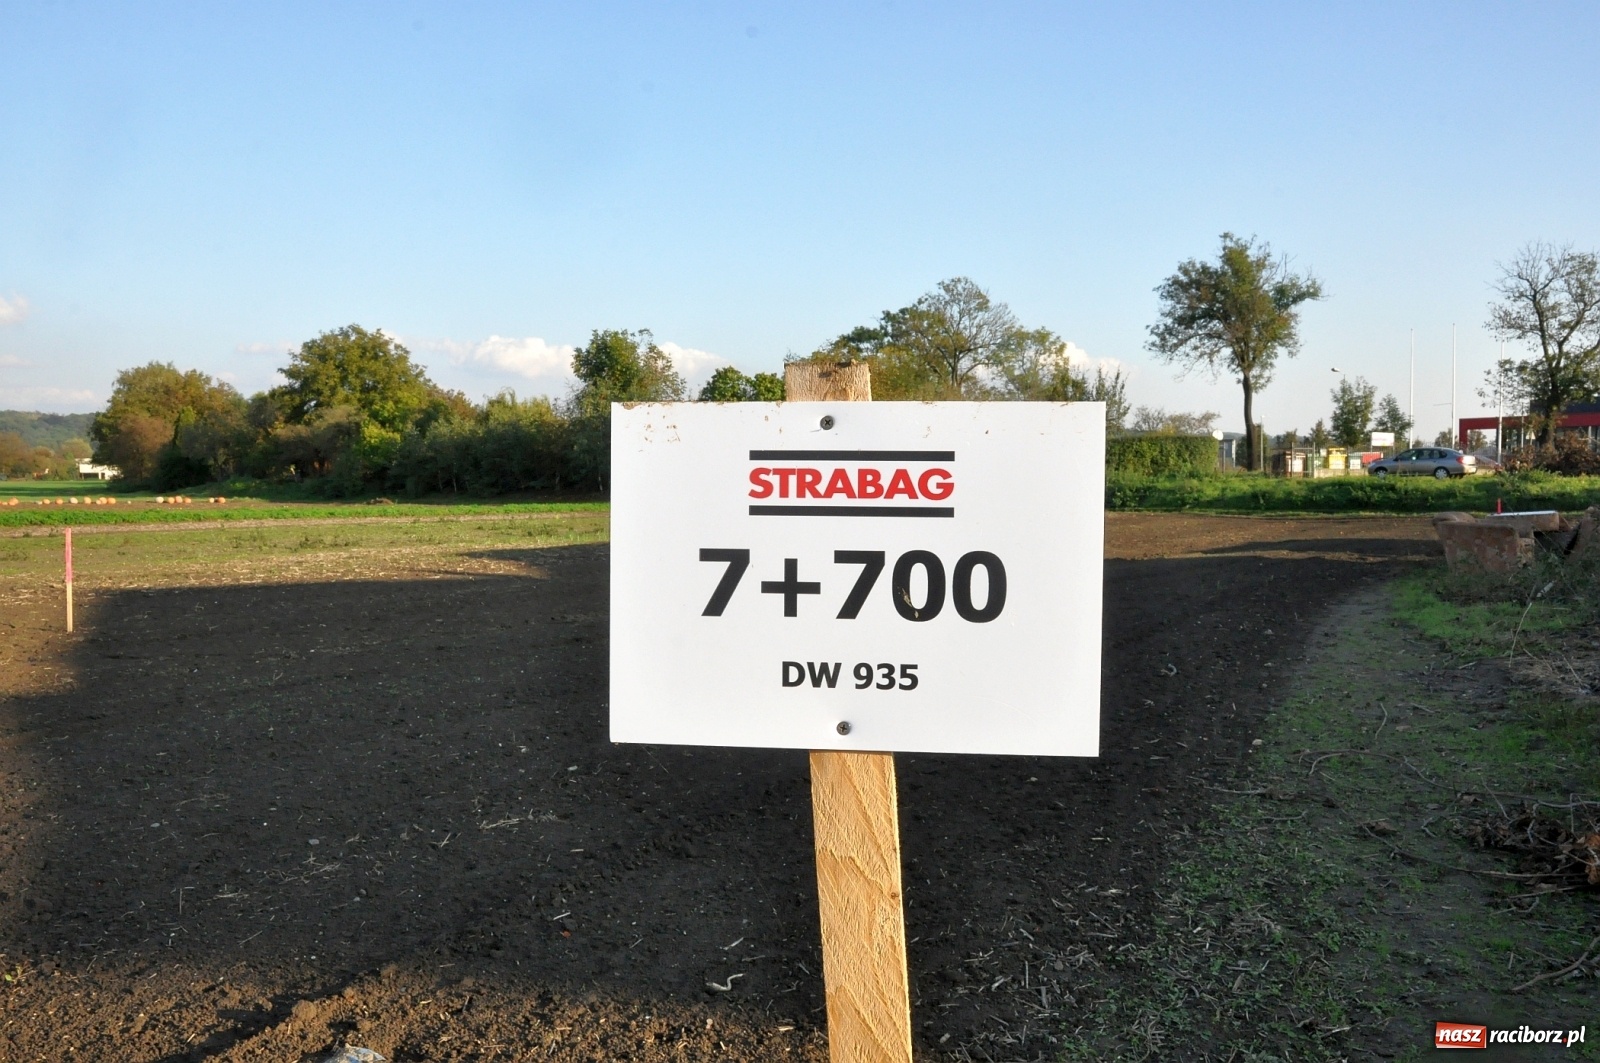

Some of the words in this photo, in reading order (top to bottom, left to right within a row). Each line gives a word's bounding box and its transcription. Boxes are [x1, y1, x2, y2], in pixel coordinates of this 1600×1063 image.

[749, 467, 955, 501] STRABAG
[700, 549, 1006, 623] 7+700
[782, 662, 842, 689] DW
[854, 662, 919, 691] 935
